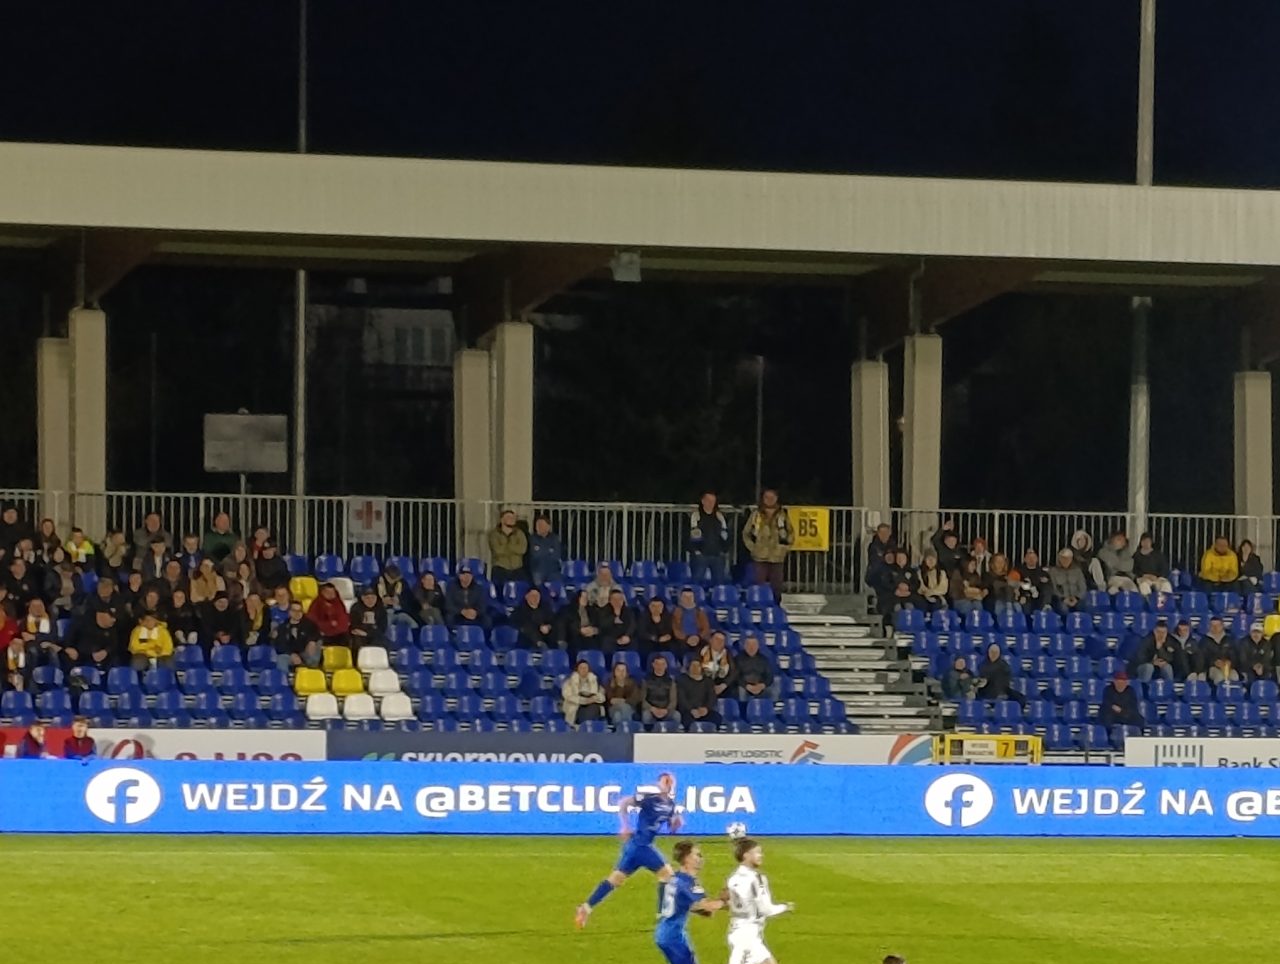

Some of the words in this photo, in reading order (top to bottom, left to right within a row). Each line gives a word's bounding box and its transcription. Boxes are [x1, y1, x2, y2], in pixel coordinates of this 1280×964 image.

[798, 518, 818, 537] B5
[1002, 742, 1010, 758] 7
[182, 777, 328, 811] WEJDŹ
[344, 784, 402, 811] NA
[1013, 782, 1146, 815] WEJDŹ
[1160, 789, 1213, 815] NA
